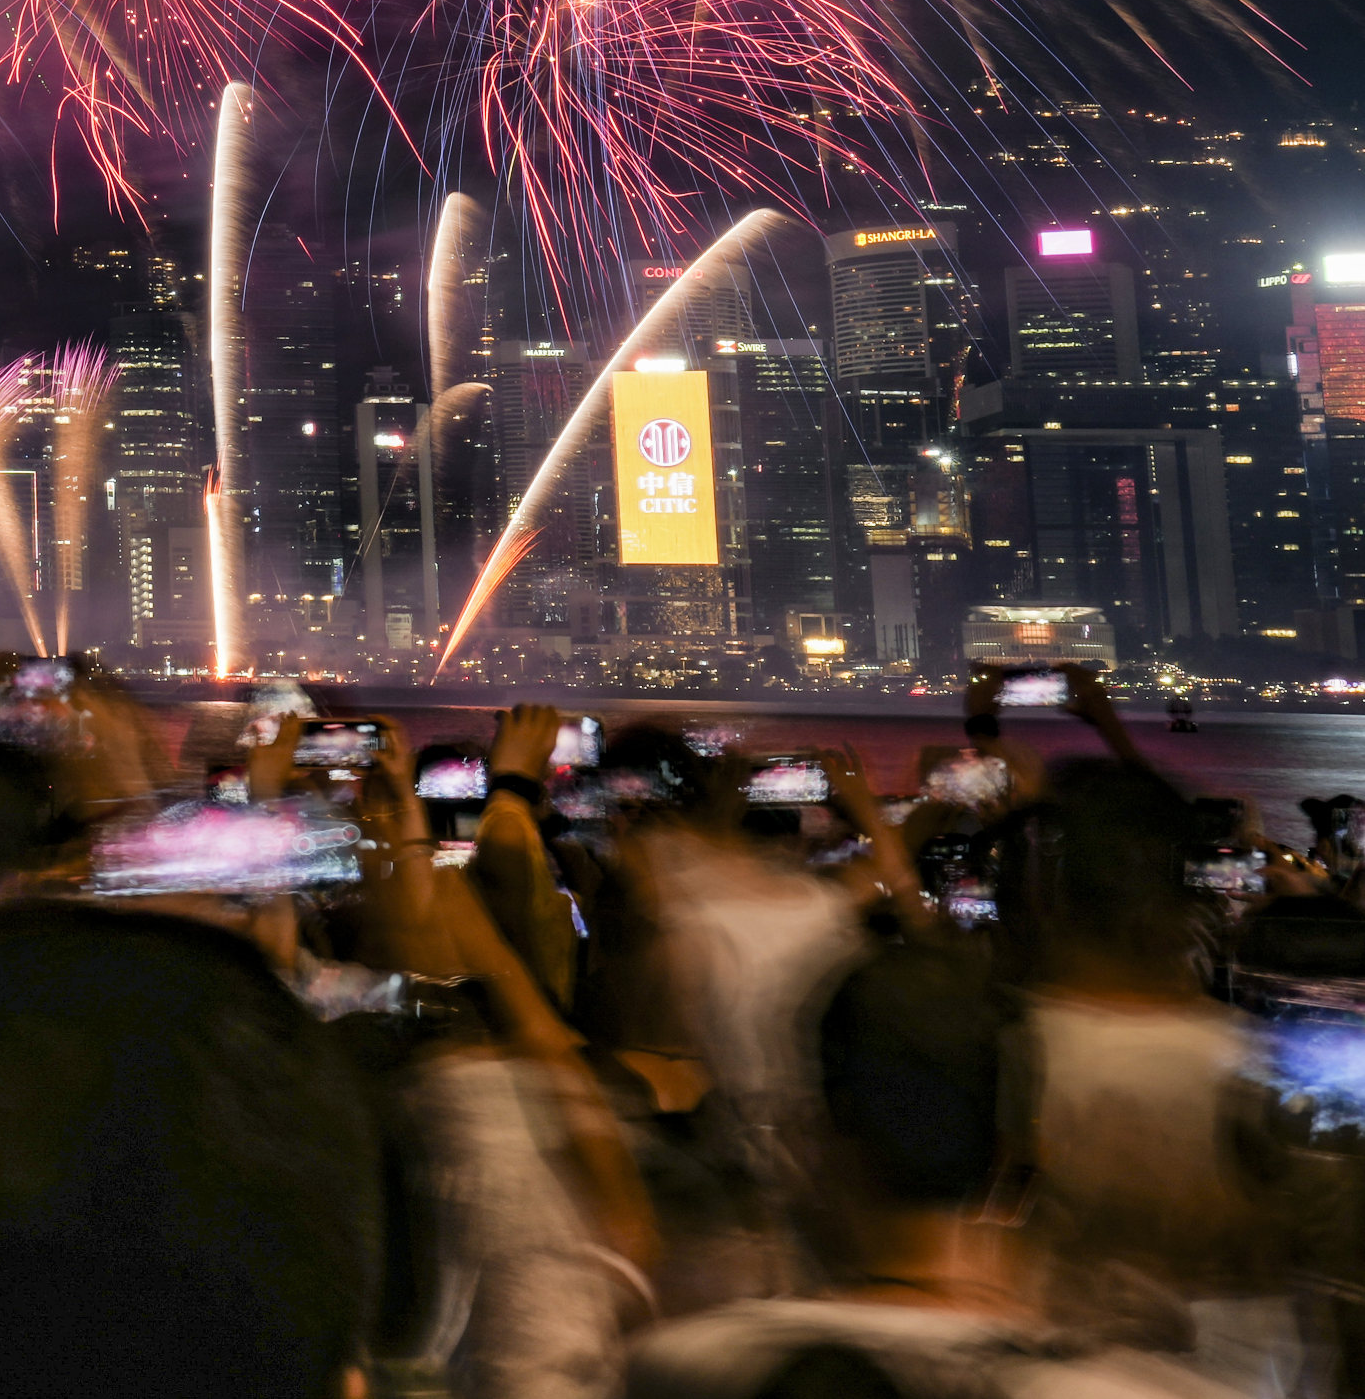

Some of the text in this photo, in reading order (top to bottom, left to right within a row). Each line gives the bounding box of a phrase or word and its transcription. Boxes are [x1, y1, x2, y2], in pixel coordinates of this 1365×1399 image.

[867, 228, 937, 244] SHANGRI-LA
[644, 266, 704, 280] CONRD
[1260, 274, 1288, 288] LIPPO
[539, 341, 551, 349] JW
[526, 349, 565, 357] MARRIOTT
[638, 471, 695, 496] 中信
[639, 497, 698, 514] CITIC
